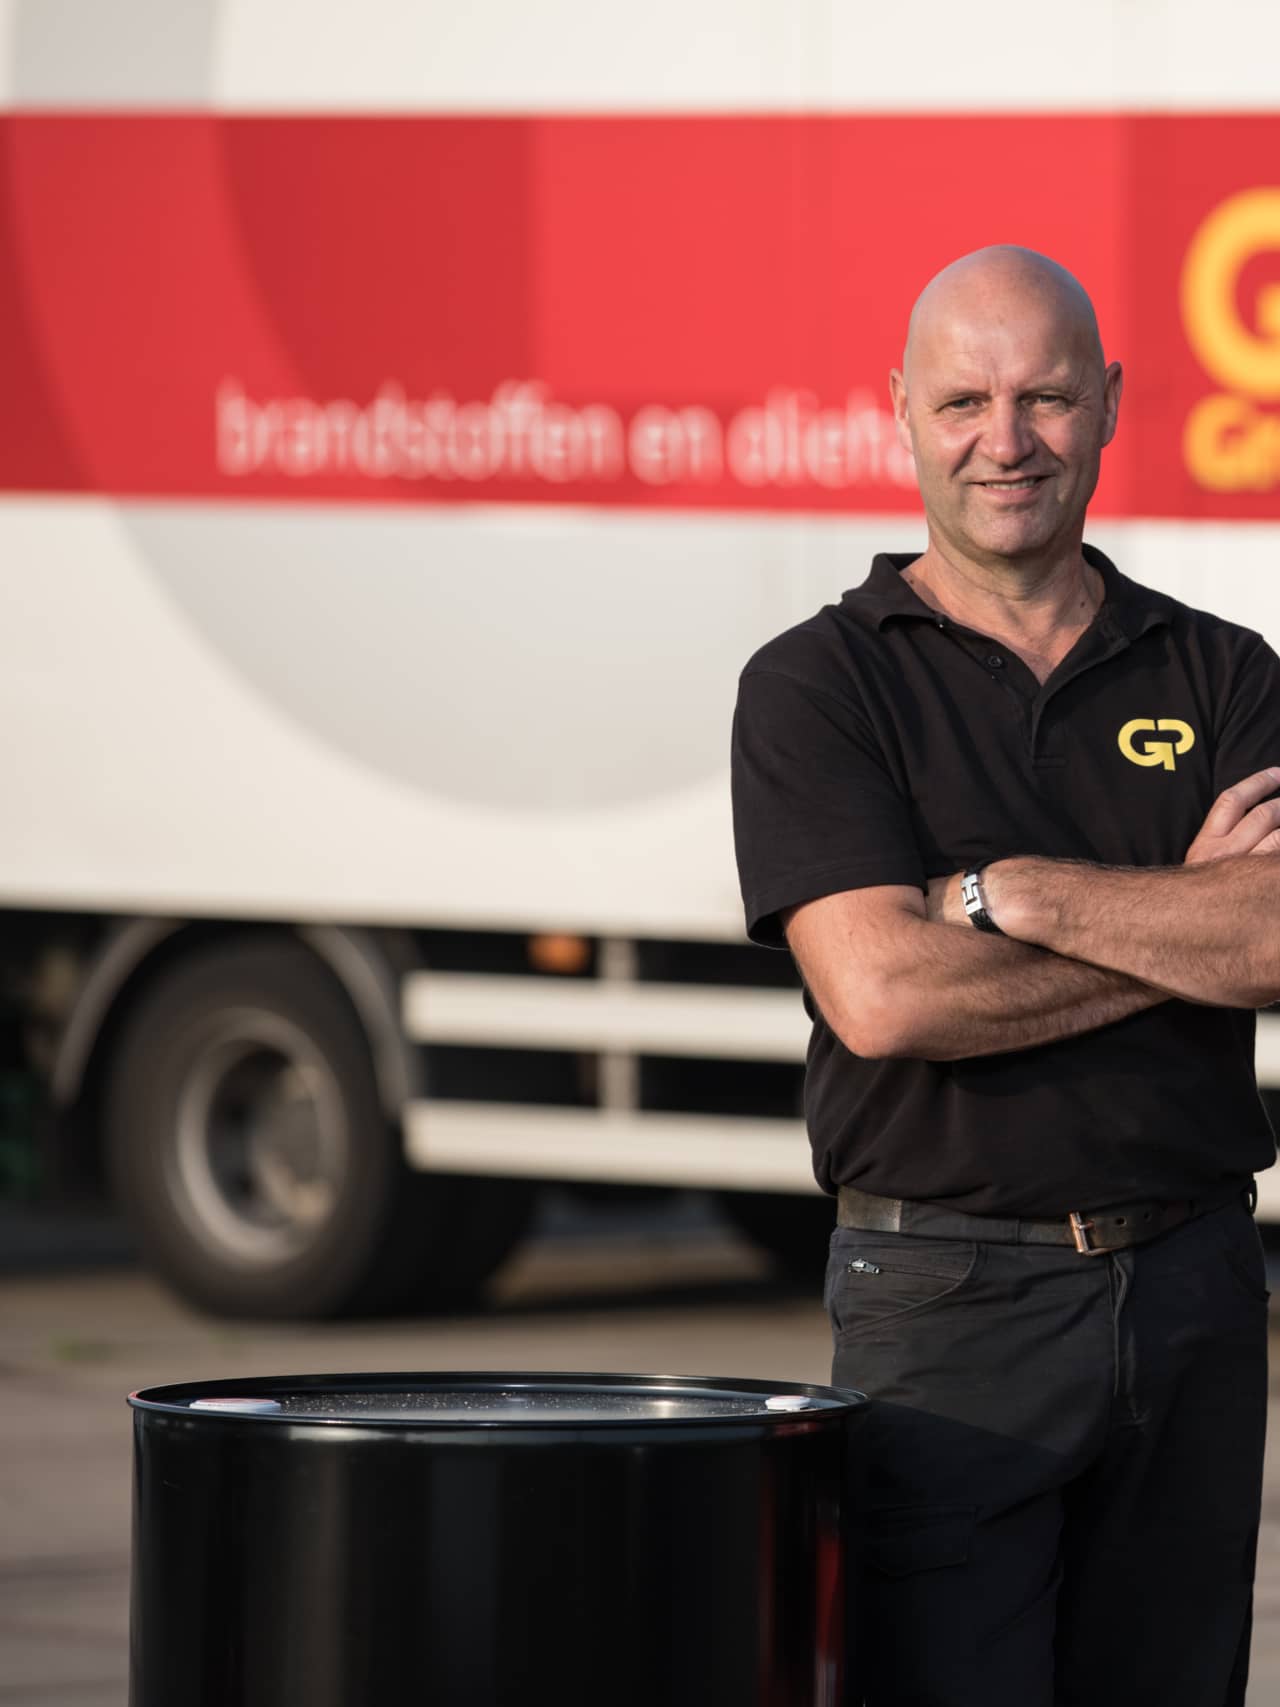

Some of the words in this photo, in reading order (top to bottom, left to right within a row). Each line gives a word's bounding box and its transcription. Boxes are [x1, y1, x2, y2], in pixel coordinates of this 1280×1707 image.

[217, 379, 622, 481] brandstoffen
[629, 402, 723, 485] en
[1118, 718, 1195, 771] GP
